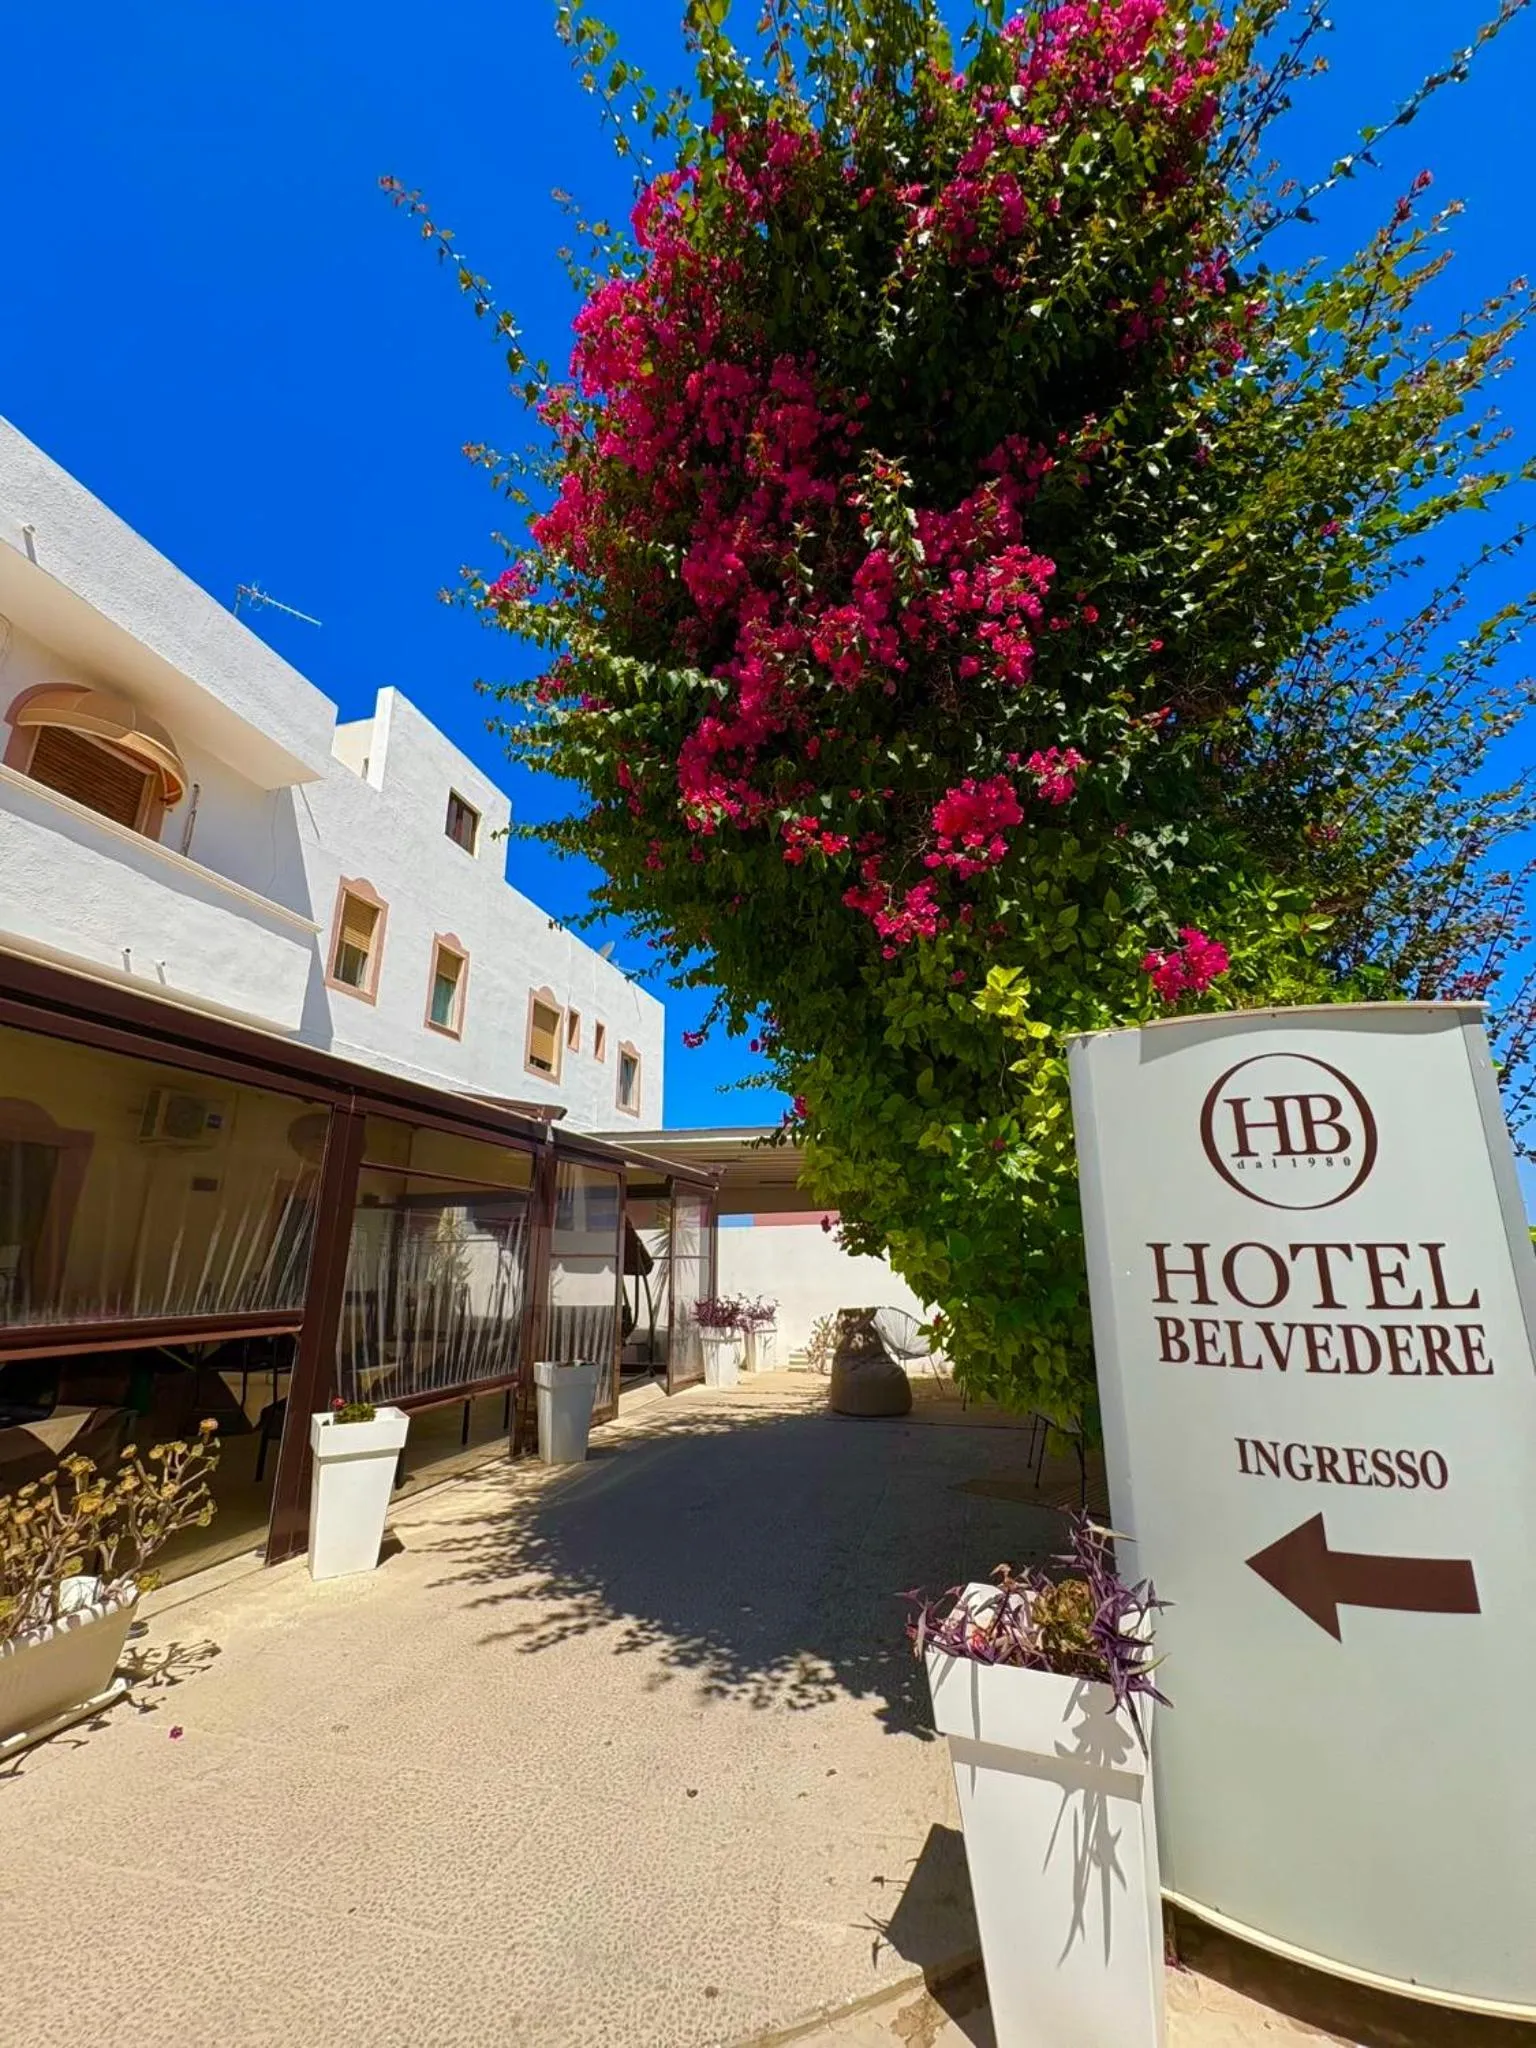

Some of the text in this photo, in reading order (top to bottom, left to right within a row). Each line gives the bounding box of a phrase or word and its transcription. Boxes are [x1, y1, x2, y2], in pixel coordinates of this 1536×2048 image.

[1222, 1093, 1352, 1158] HB
[1236, 1156, 1352, 1170] dal 1980
[1146, 1242, 1481, 1310] HOTEL
[1154, 1316, 1495, 1376] BELVEDERE
[1234, 1437, 1449, 1490] INGRESSO
